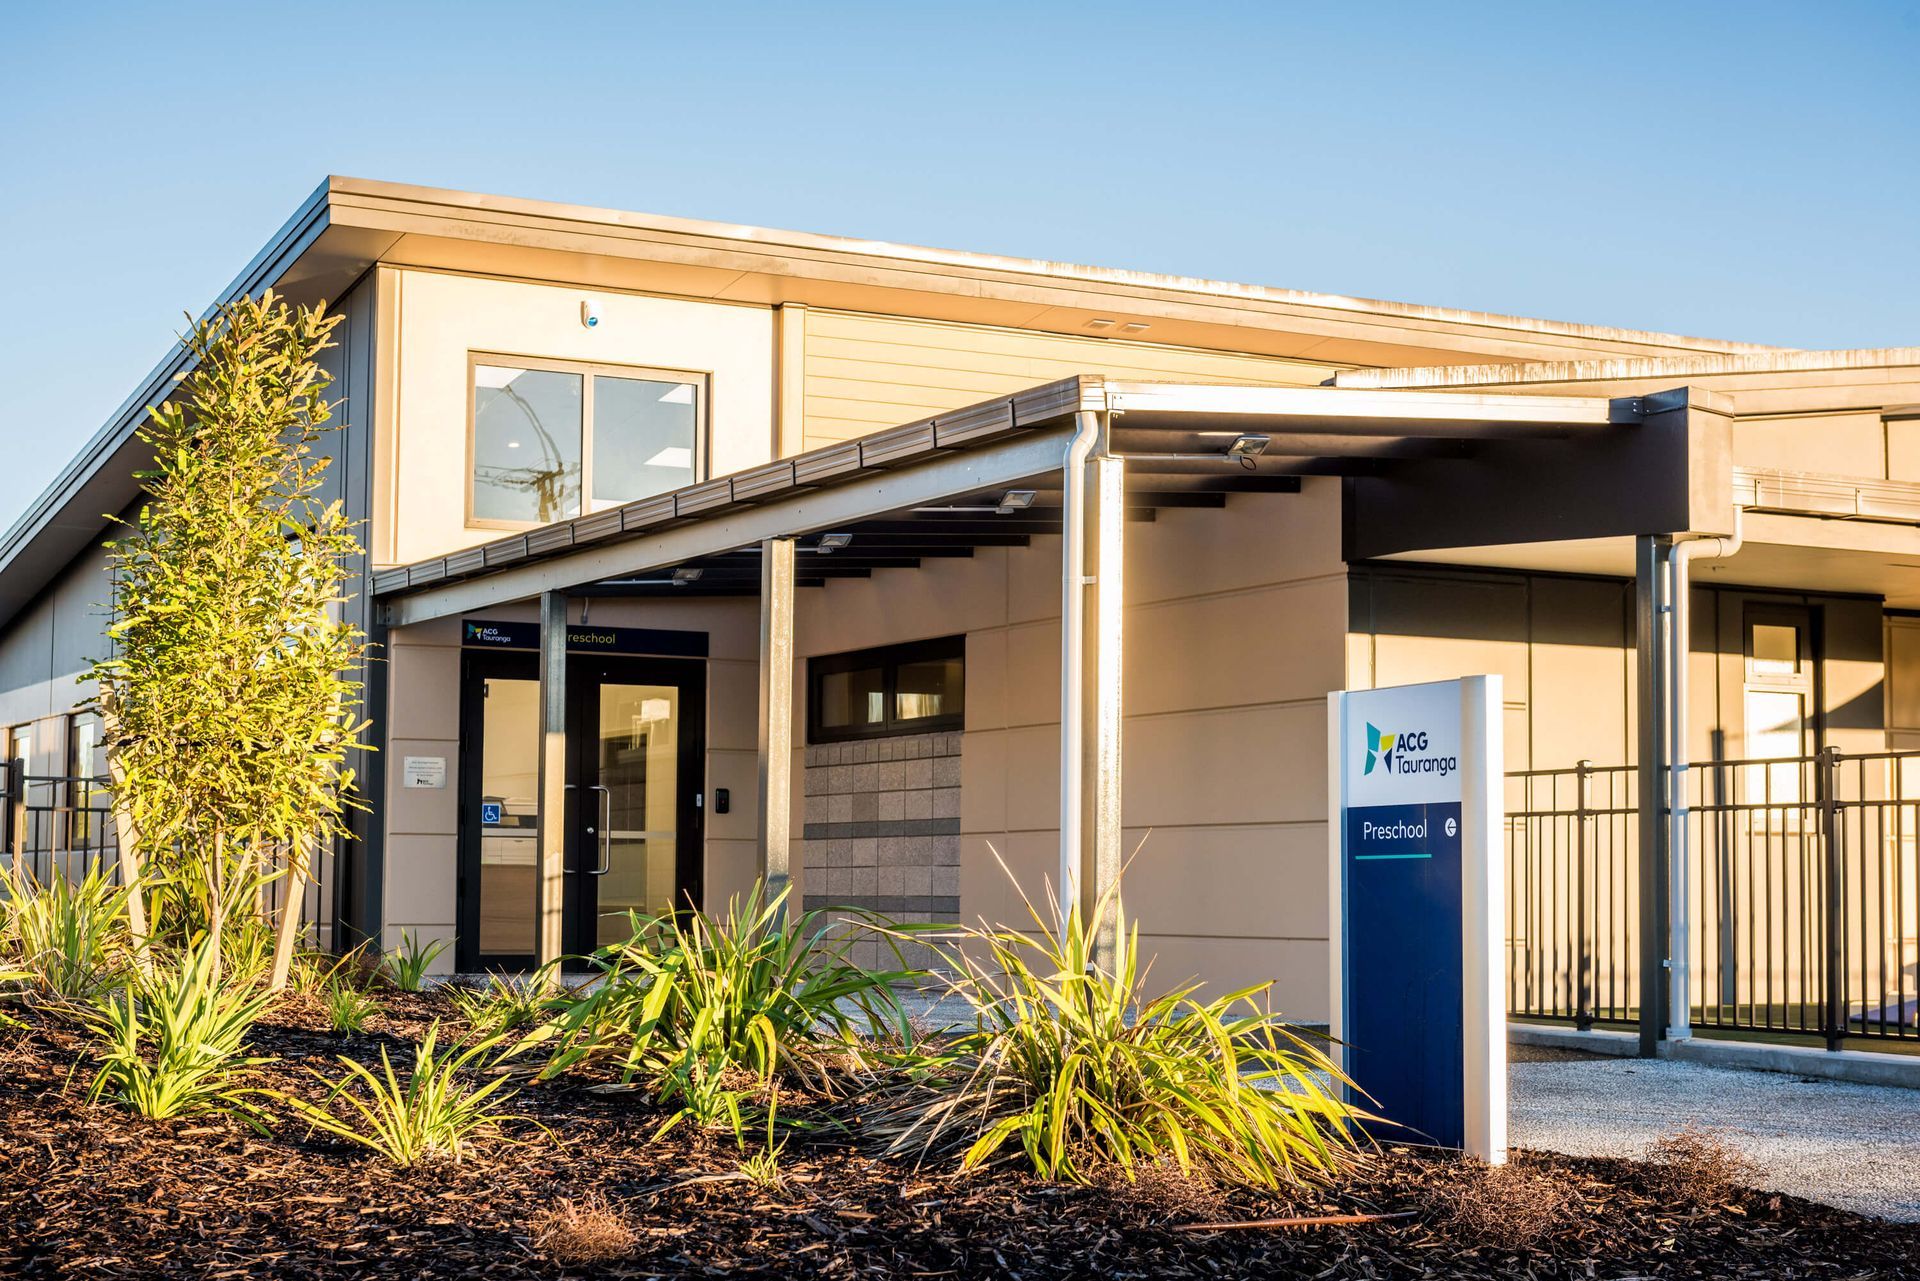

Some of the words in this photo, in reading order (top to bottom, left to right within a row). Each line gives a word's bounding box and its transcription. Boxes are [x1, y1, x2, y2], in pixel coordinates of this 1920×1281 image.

[483, 635, 511, 643] Tauranga
[567, 632, 616, 644] reschool
[1396, 731, 1428, 753] ACG
[1395, 755, 1456, 776] Tauranga
[1363, 818, 1427, 840] Preschool
